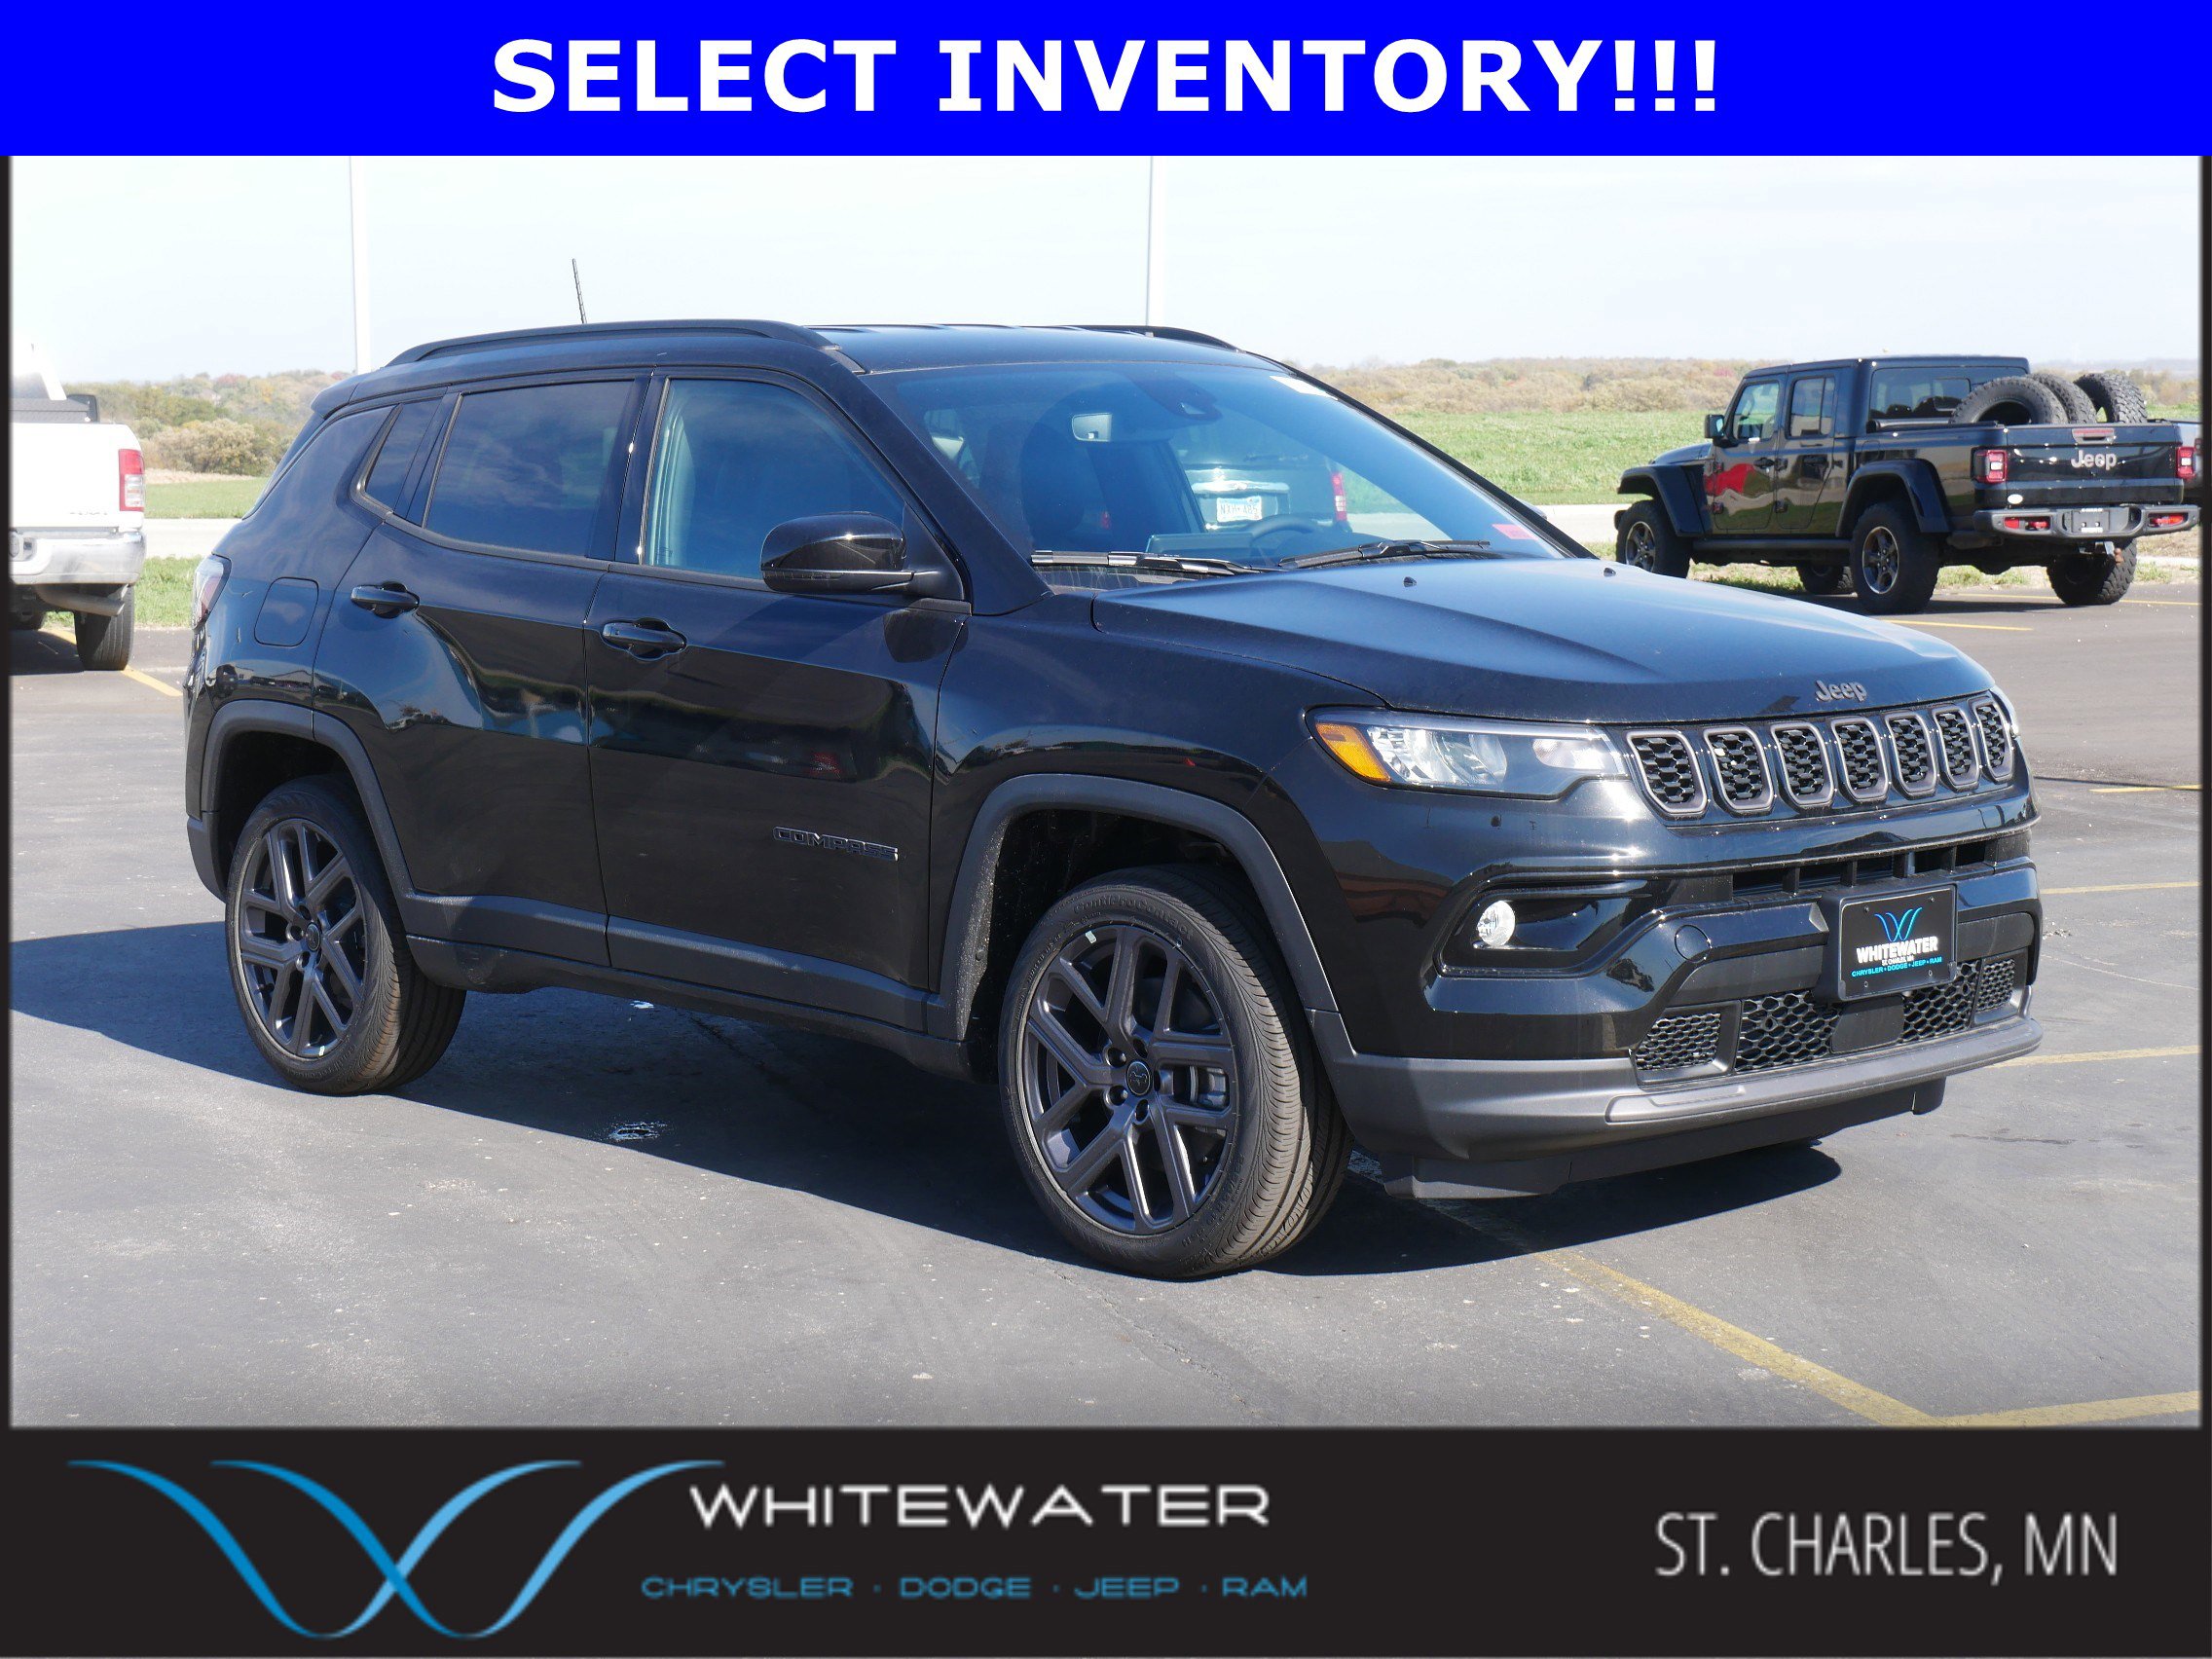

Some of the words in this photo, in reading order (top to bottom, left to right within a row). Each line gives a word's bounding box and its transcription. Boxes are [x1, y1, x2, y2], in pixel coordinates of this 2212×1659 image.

[2071, 450, 2117, 470] Jeep
[1815, 680, 1867, 702] Jeep
[773, 827, 899, 861] COMPASS
[1856, 936, 1938, 964] WHITEWATER
[1851, 966, 1884, 977] CHRYSLER
[1887, 963, 1908, 972] DODGE
[1911, 959, 1927, 968] JEEP
[1929, 956, 1942, 965] RAM
